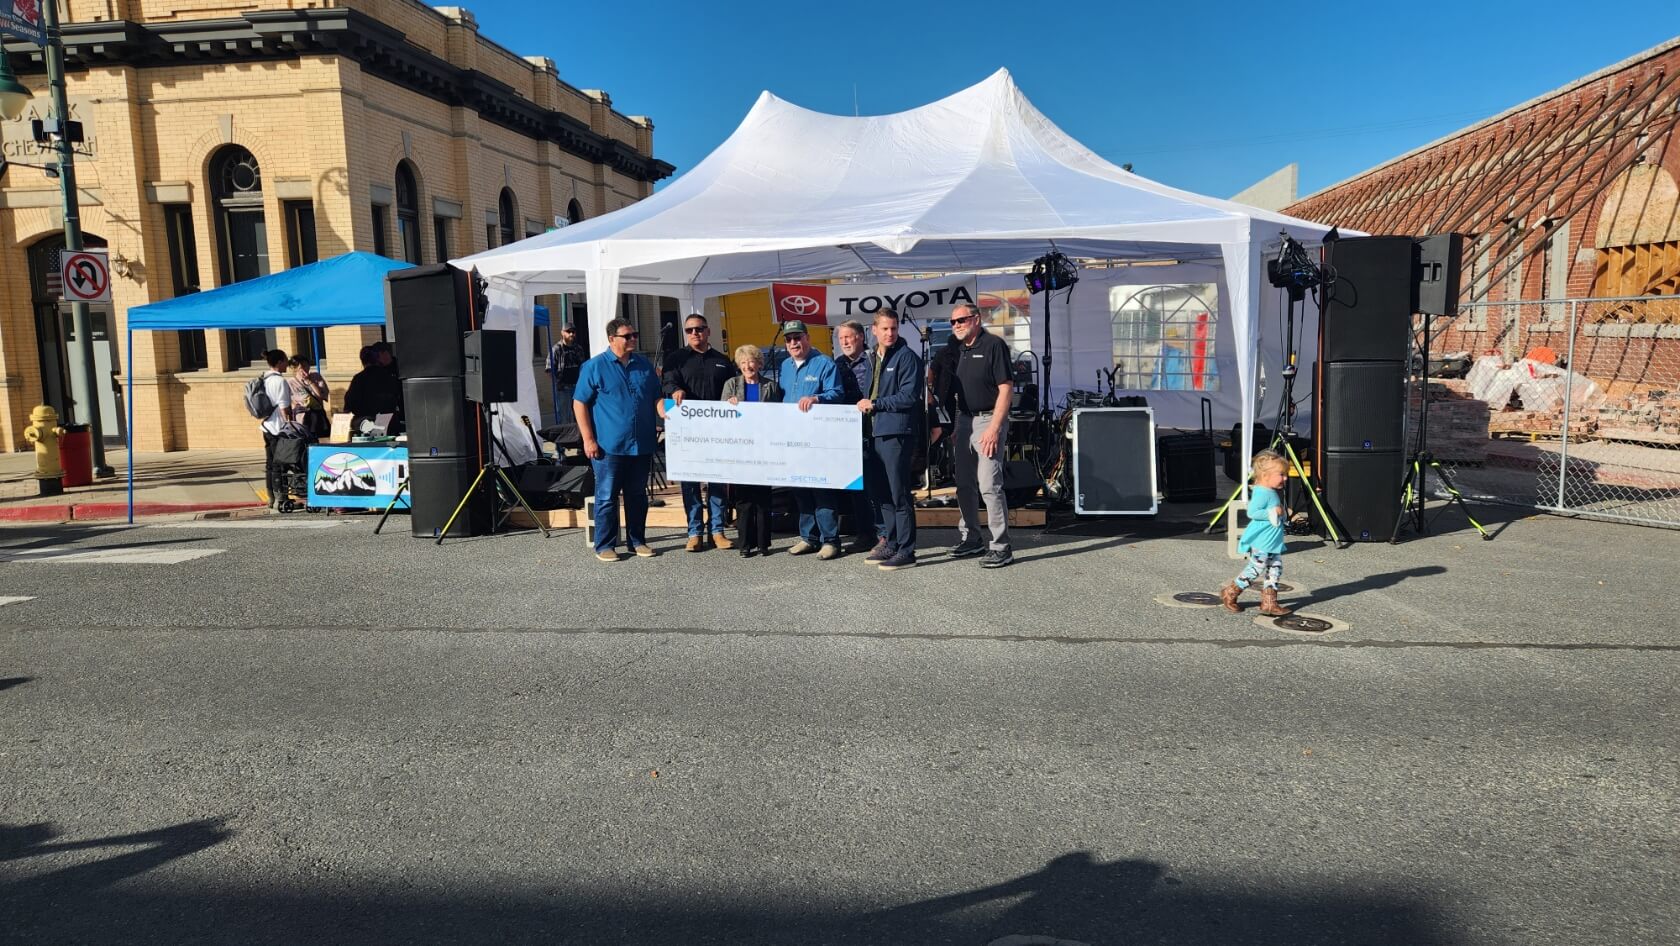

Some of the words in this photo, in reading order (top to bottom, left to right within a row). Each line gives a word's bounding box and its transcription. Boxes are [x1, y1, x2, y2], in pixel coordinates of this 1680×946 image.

[10, 21, 41, 38] Seasons
[13, 103, 81, 123] AK
[839, 286, 974, 315] TOYOTA
[680, 405, 739, 420] Spectrum
[683, 436, 710, 445] INNOVIA
[711, 437, 755, 446] FOUNDATION
